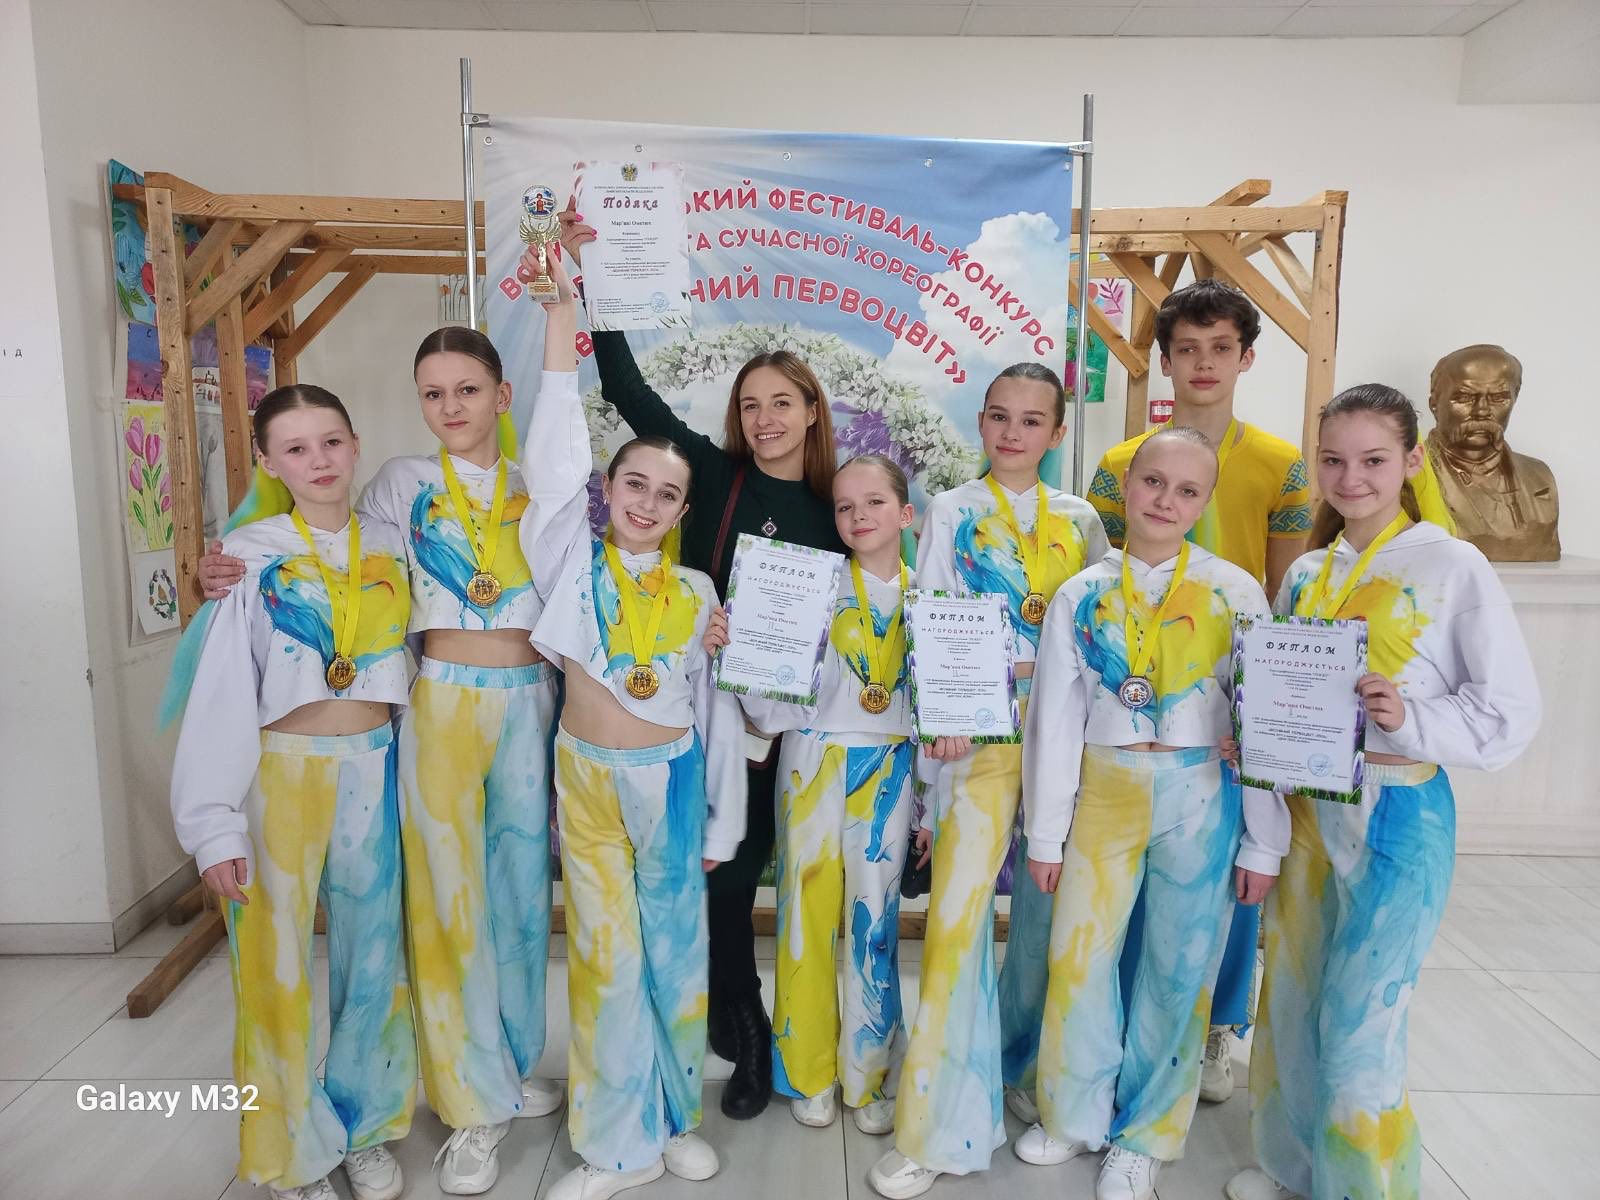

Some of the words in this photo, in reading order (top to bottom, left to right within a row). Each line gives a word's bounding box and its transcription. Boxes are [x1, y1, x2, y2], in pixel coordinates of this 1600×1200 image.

[603, 196, 659, 211] Подяка
[717, 227, 855, 259] СУЧАСНОЇ
[854, 244, 1005, 346] ХОРЕОГРАФІЇ
[767, 187, 1056, 357] ФЕСТИВАЛЬ-КОНКУРС
[772, 273, 966, 384] ПЕРВОЦВІТ»
[929, 612, 985, 622] ДИПЛОМ
[1265, 641, 1336, 655] ДИПЛОМ
